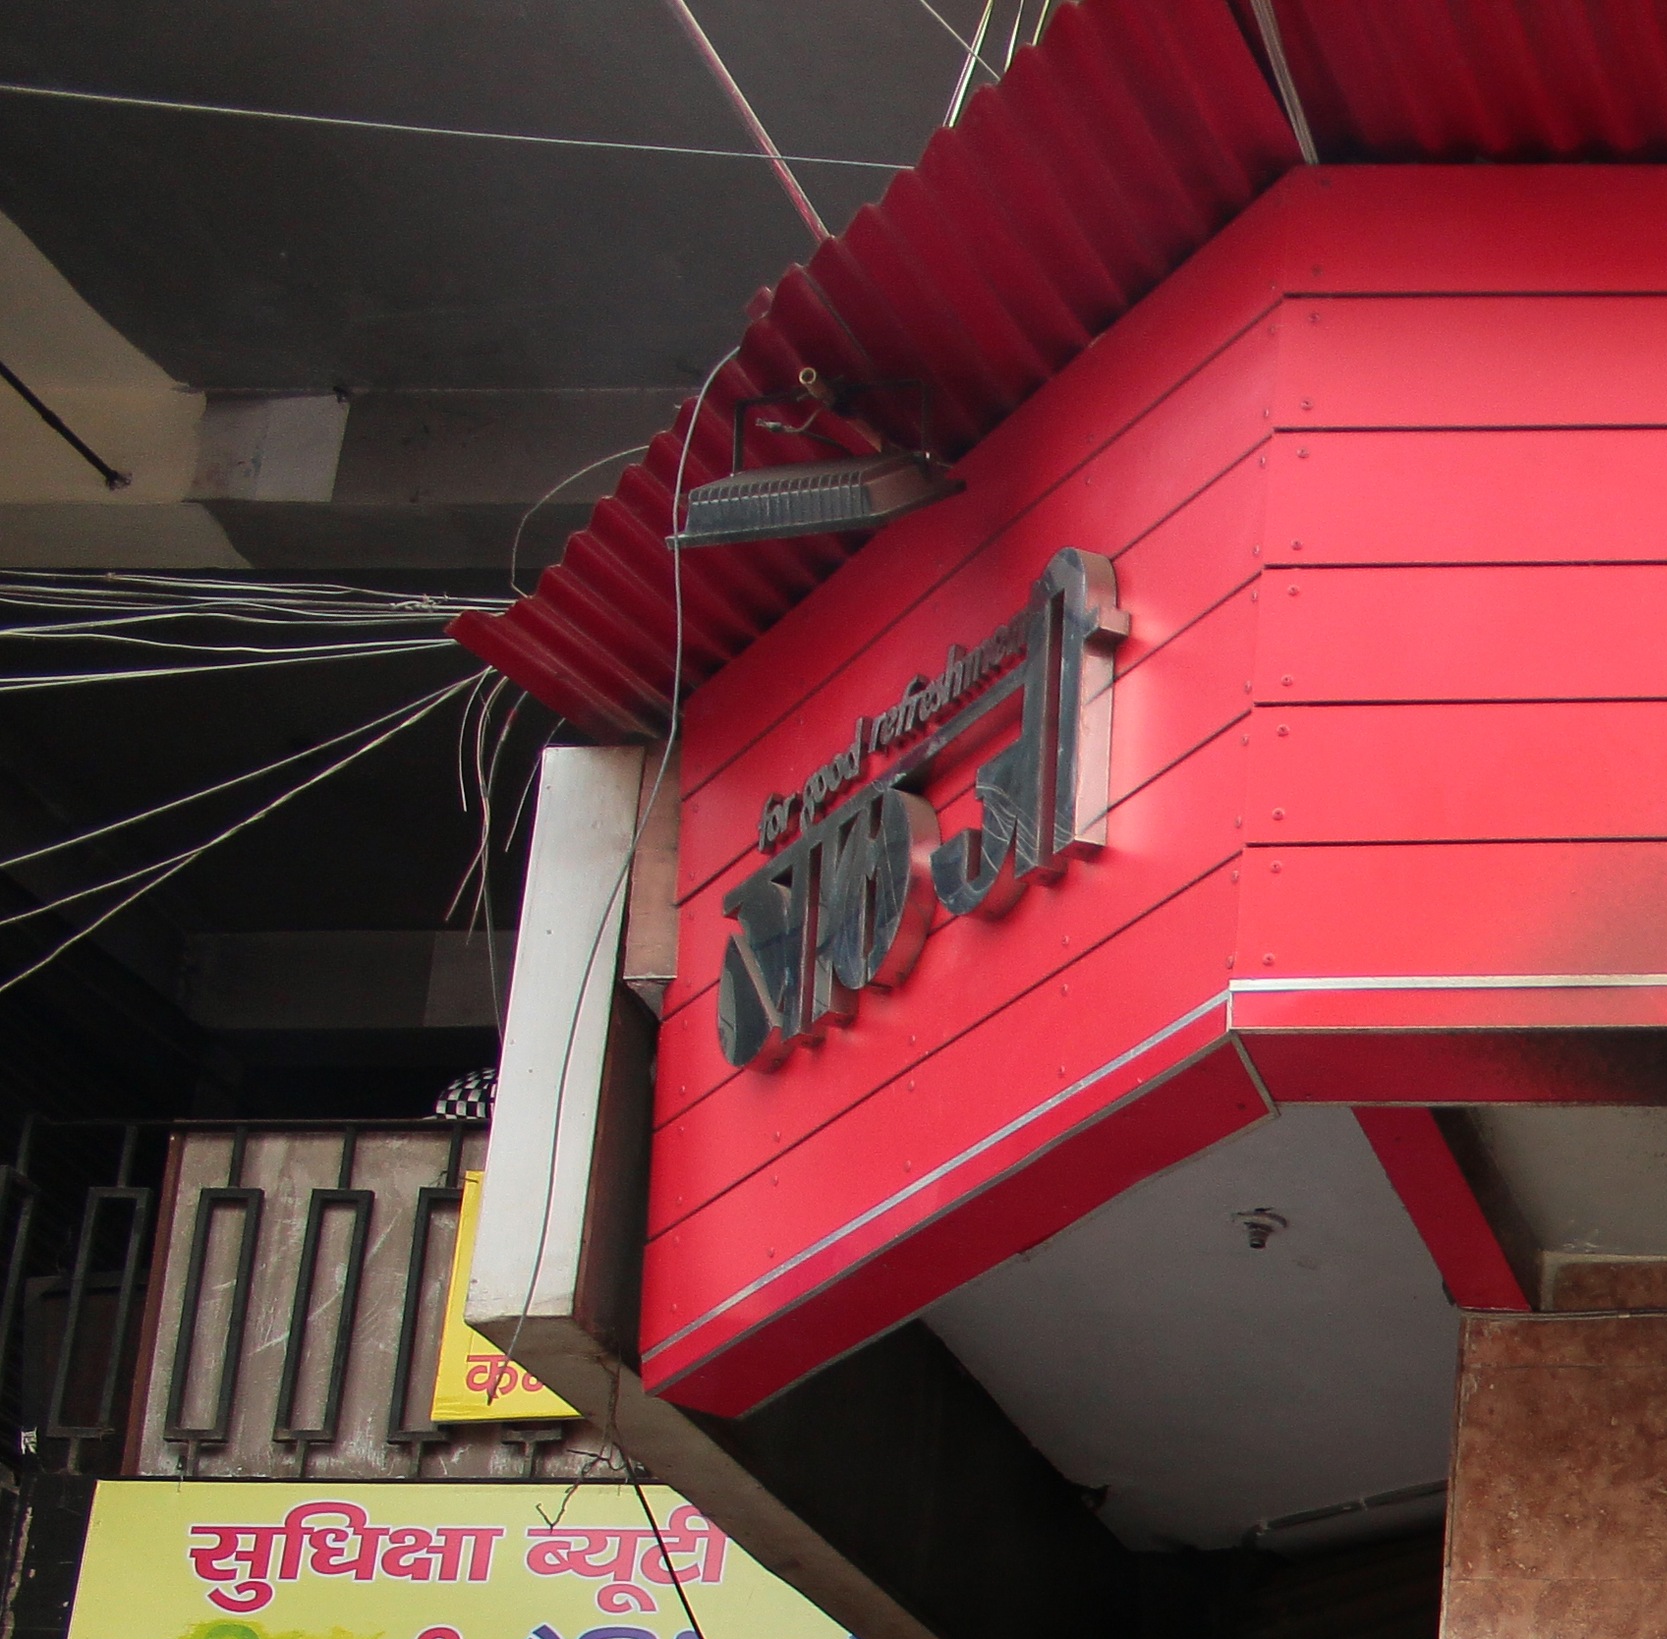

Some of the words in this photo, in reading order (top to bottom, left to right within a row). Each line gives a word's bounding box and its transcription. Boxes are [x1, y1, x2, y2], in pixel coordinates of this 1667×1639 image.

[757, 792, 796, 853] for
[800, 718, 864, 831] good
[189, 1500, 502, 1613] सुधिक्षा
[523, 1508, 738, 1611] ब्यूटी
